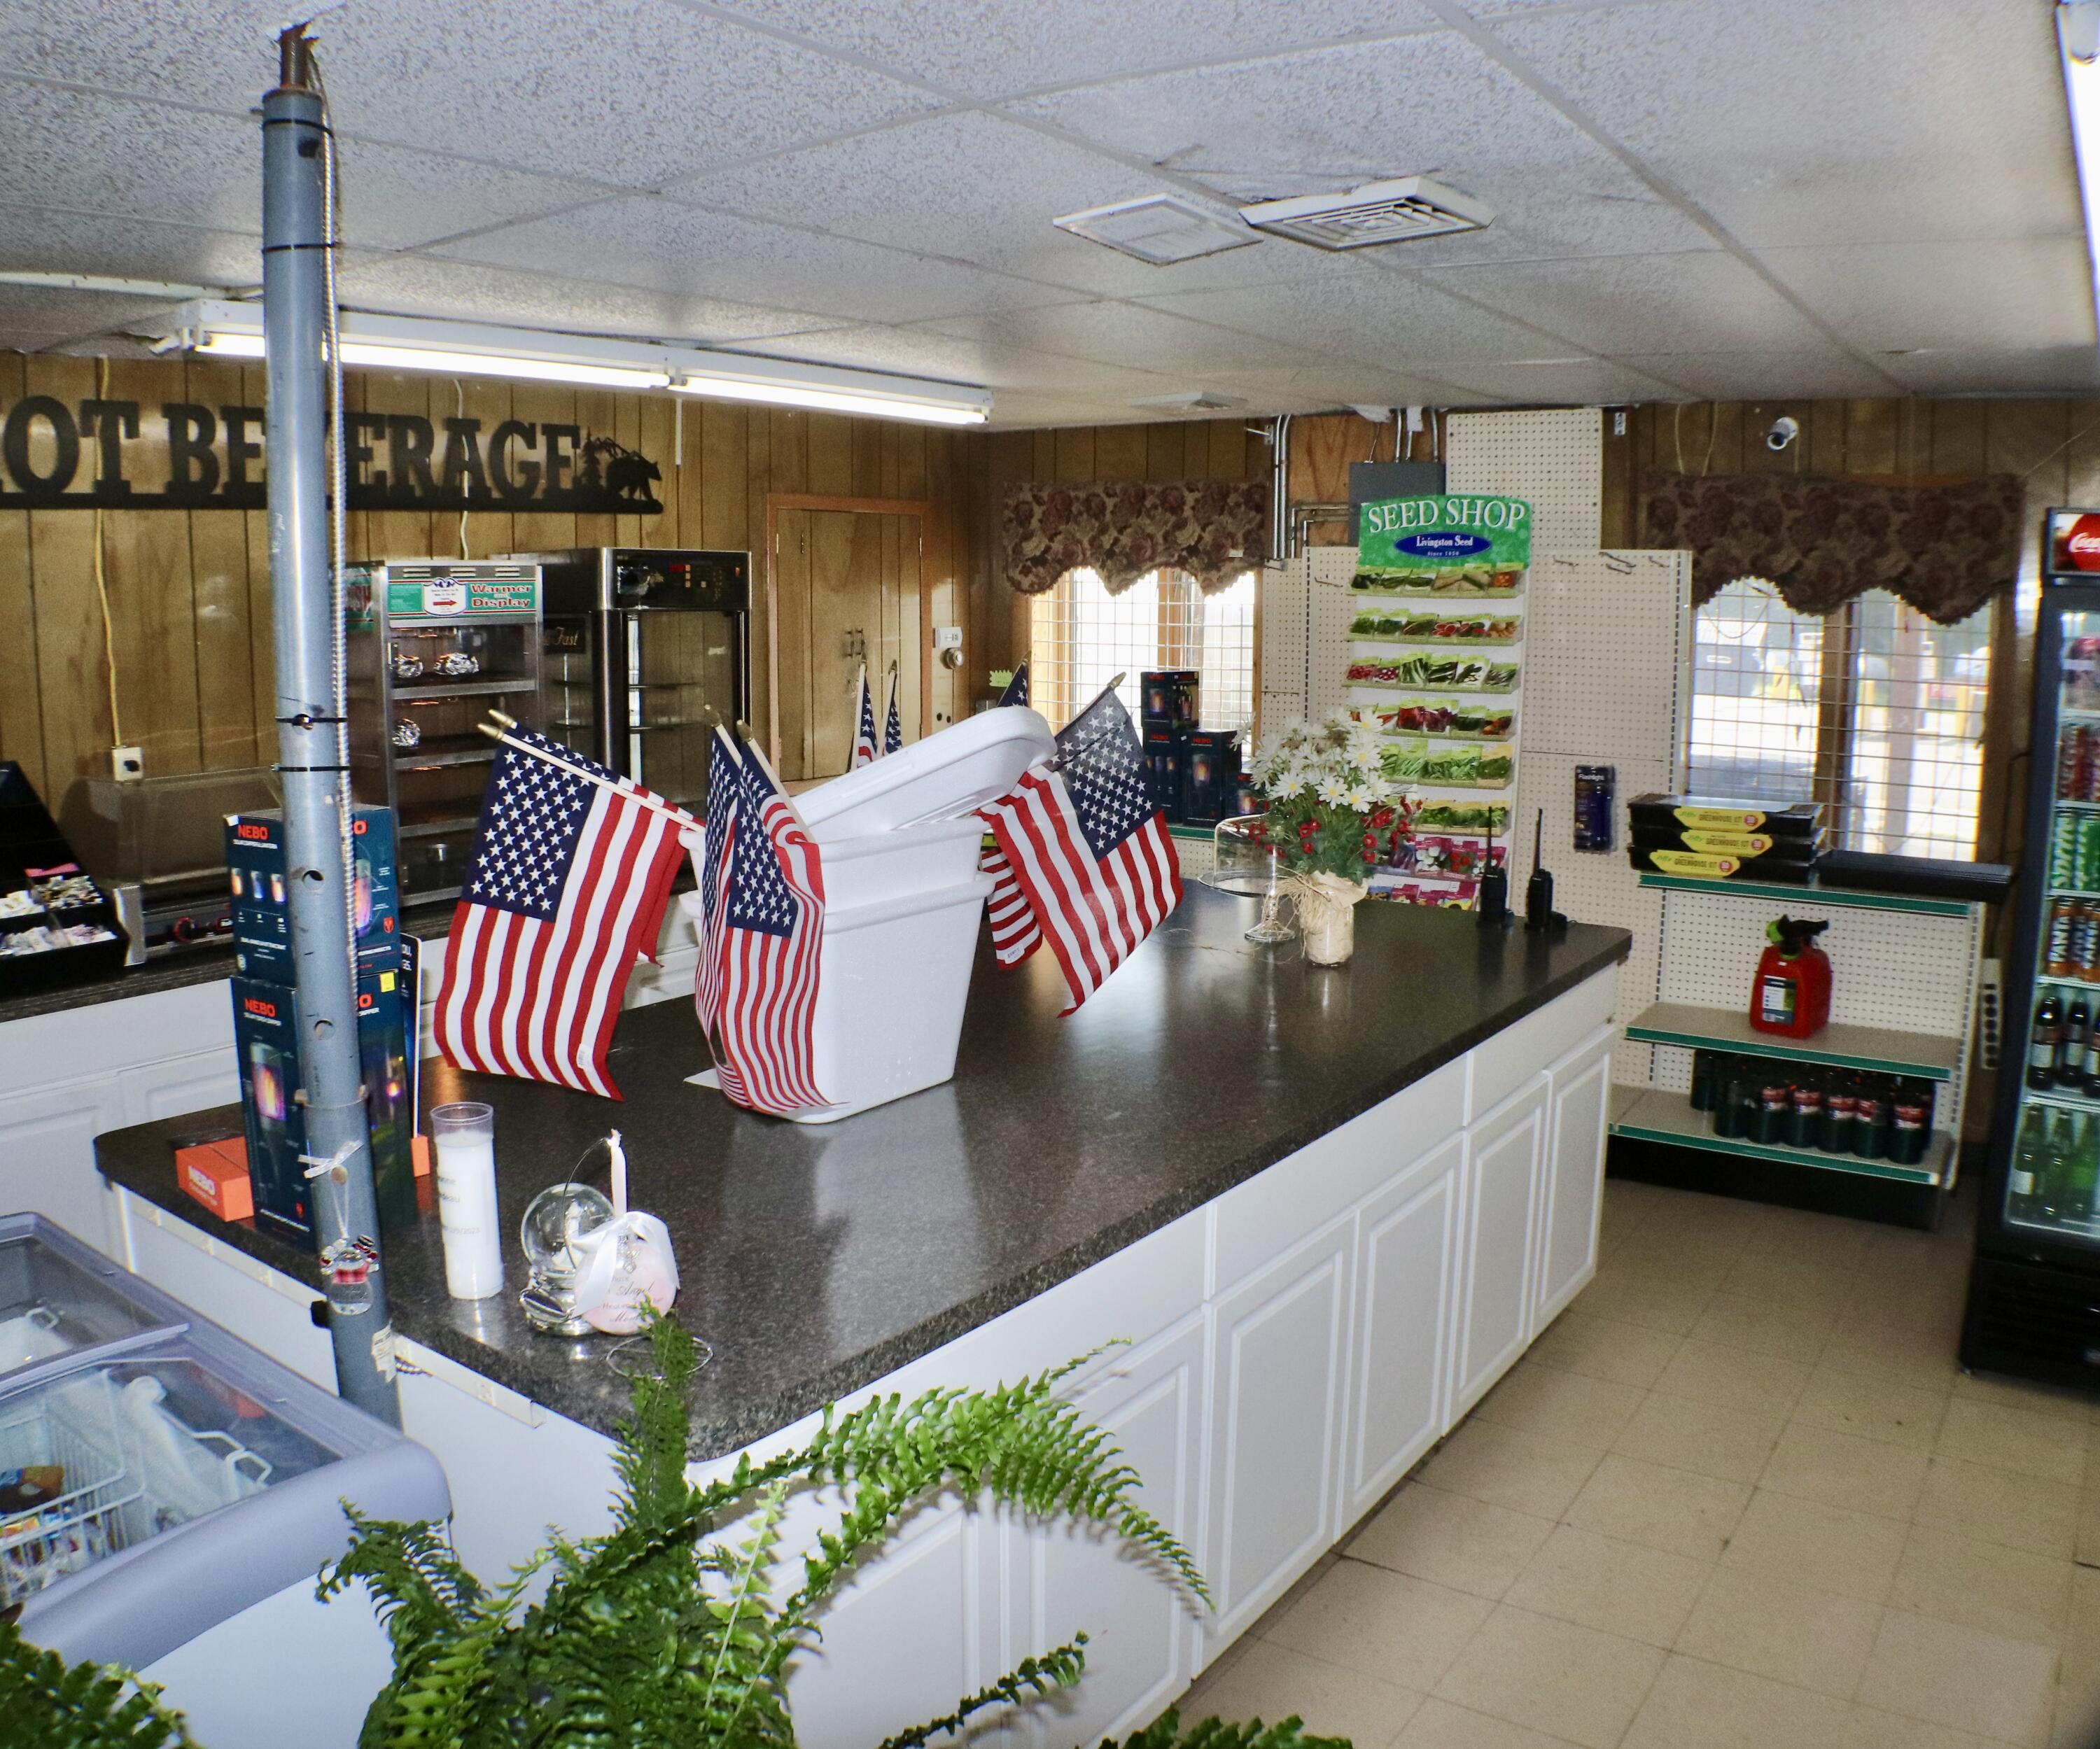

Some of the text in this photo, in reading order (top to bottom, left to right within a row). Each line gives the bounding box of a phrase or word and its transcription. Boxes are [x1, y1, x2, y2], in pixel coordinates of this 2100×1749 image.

[0, 395, 581, 501] OT BEERAGE
[1368, 498, 1525, 533] SEED SHOP
[1416, 535, 1474, 548] Livingston Seed
[470, 584, 531, 594] Warmer
[471, 597, 531, 607] Display
[237, 824, 269, 841] NEBO
[244, 998, 276, 1018] NEBO
[616, 1281, 656, 1300] Angel
